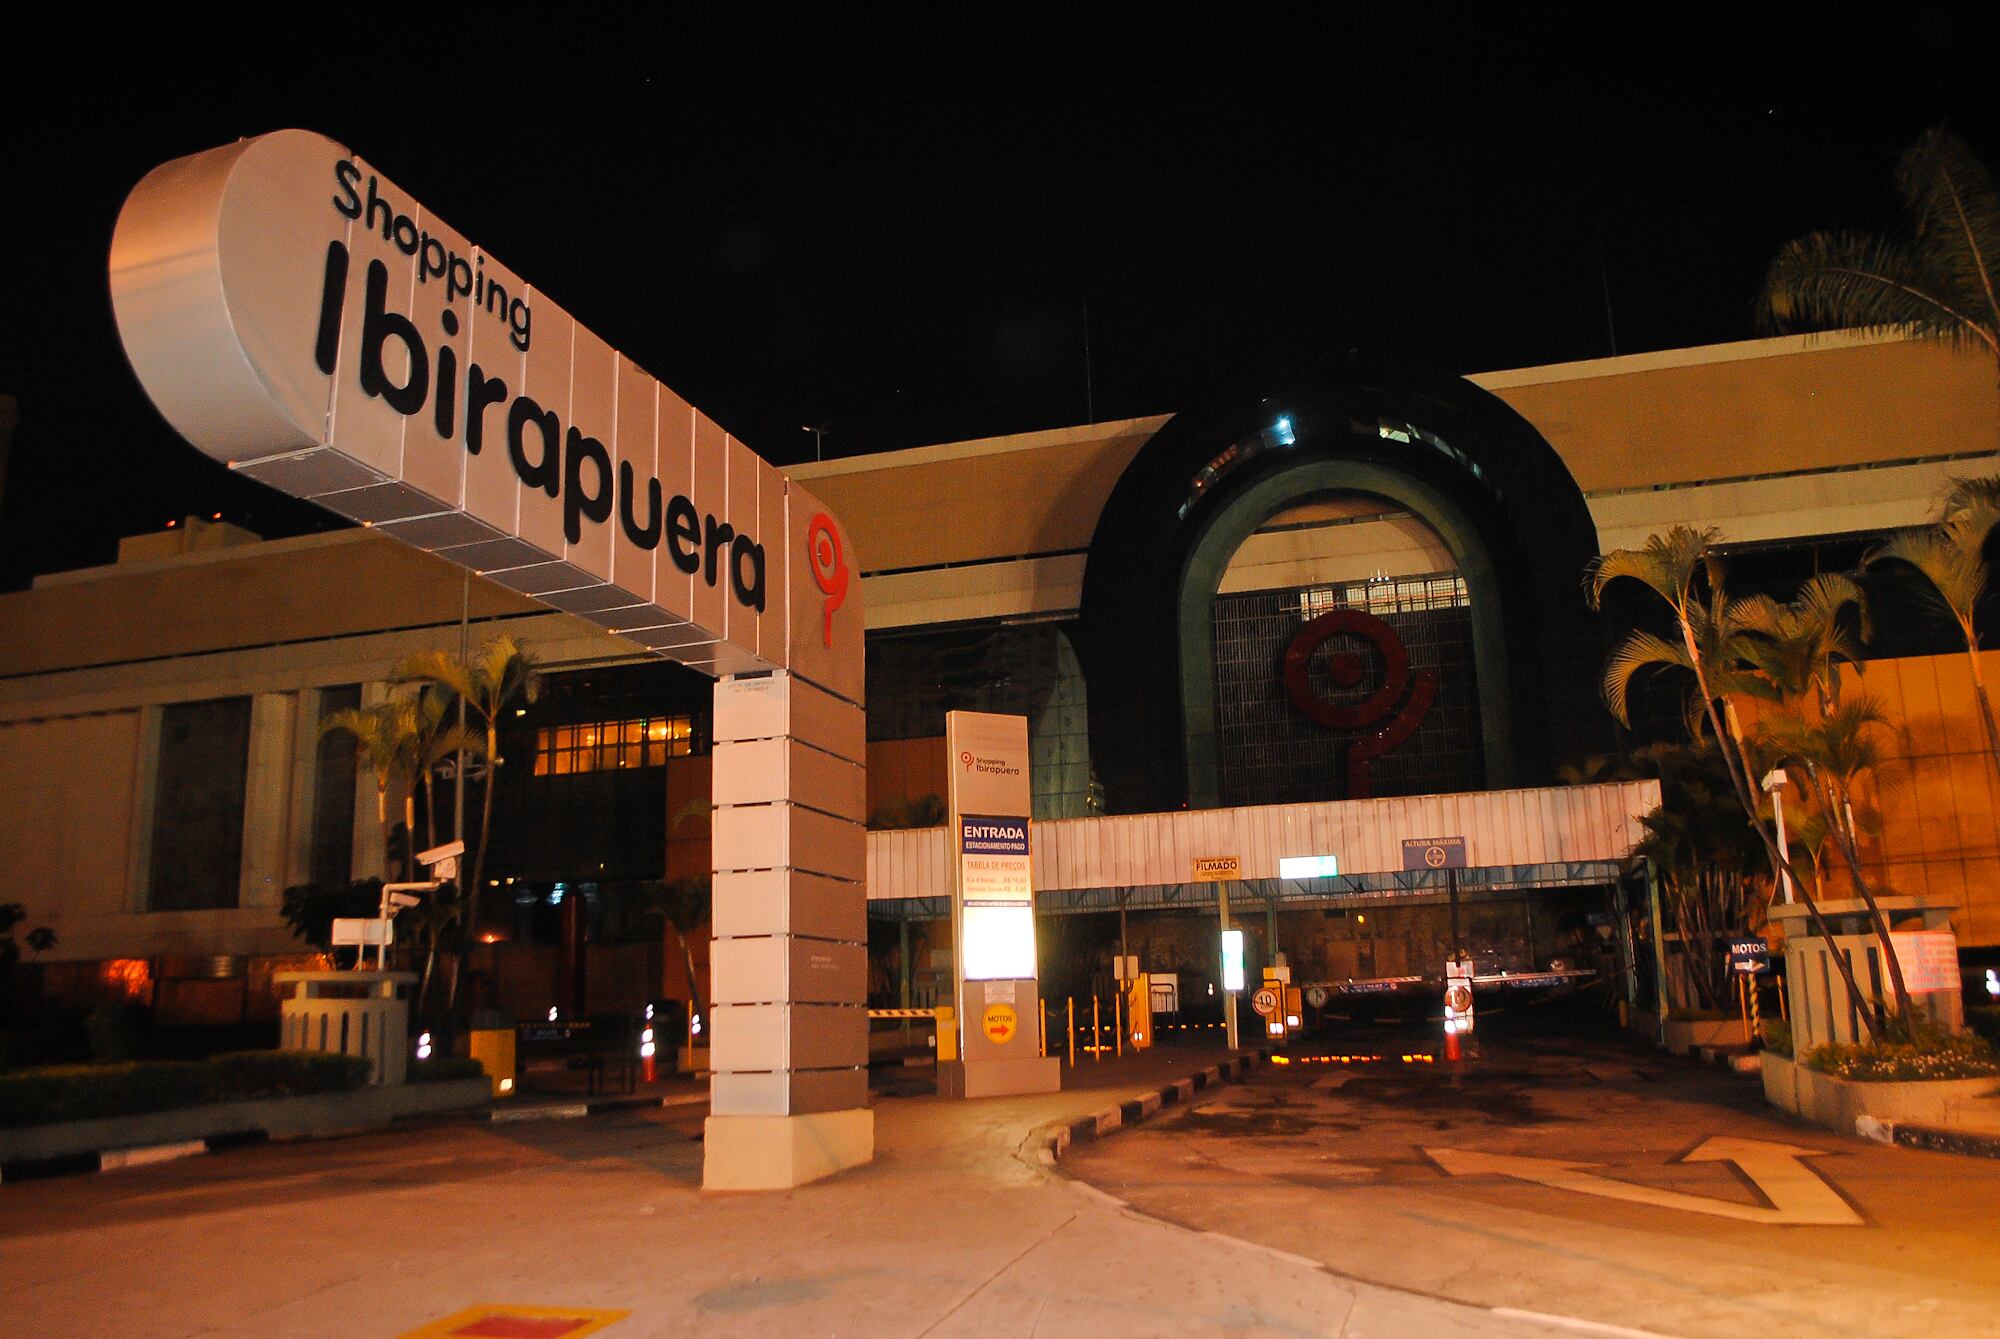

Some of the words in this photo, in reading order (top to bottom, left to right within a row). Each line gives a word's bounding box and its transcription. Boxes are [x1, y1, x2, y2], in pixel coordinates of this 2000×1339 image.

[333, 160, 531, 352] Shopping
[315, 240, 766, 613] Ibirapuera
[976, 757, 1006, 767] Shopping
[976, 764, 1020, 775] Ibirapuera
[964, 826, 1025, 839] ENTRADA
[965, 841, 1010, 850] ESTACIONAMENTO
[1011, 842, 1026, 851] PAGO
[967, 861, 990, 870] TABELA
[991, 861, 1000, 870] DE
[1000, 861, 1026, 872] PREÇOS
[1196, 861, 1238, 871] FILMADO
[1731, 943, 1767, 954] MOTOS
[1260, 995, 1272, 1006] 10
